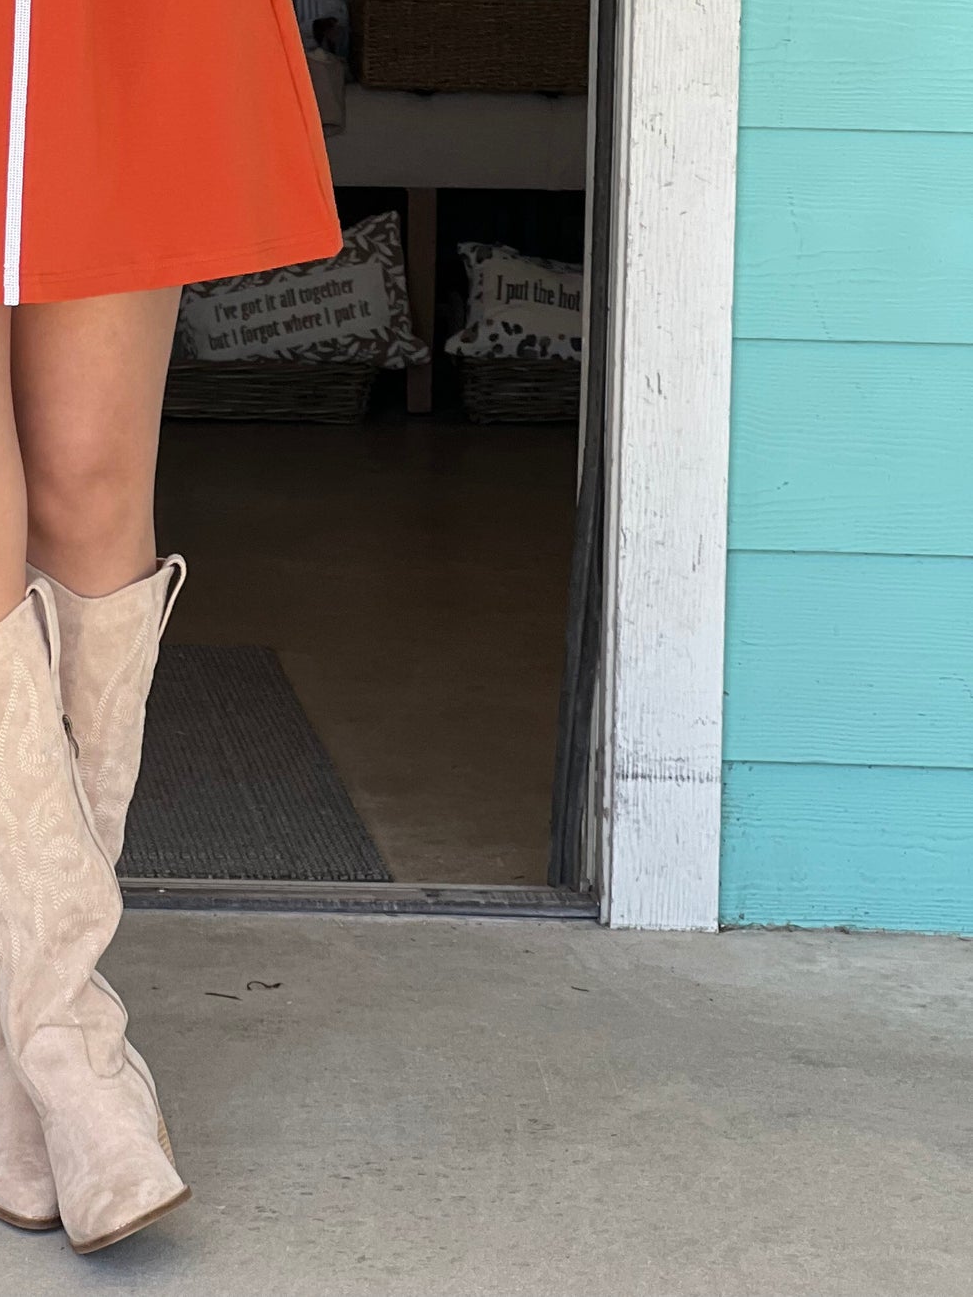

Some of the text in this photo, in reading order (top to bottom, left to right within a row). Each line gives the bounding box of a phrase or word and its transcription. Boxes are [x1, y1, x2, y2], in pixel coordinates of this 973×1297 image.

[214, 279, 355, 323] I've got it all together
[496, 274, 503, 301] I
[505, 280, 529, 305] put
[533, 279, 555, 306] the
[208, 299, 372, 352] but I forgot where I put it
